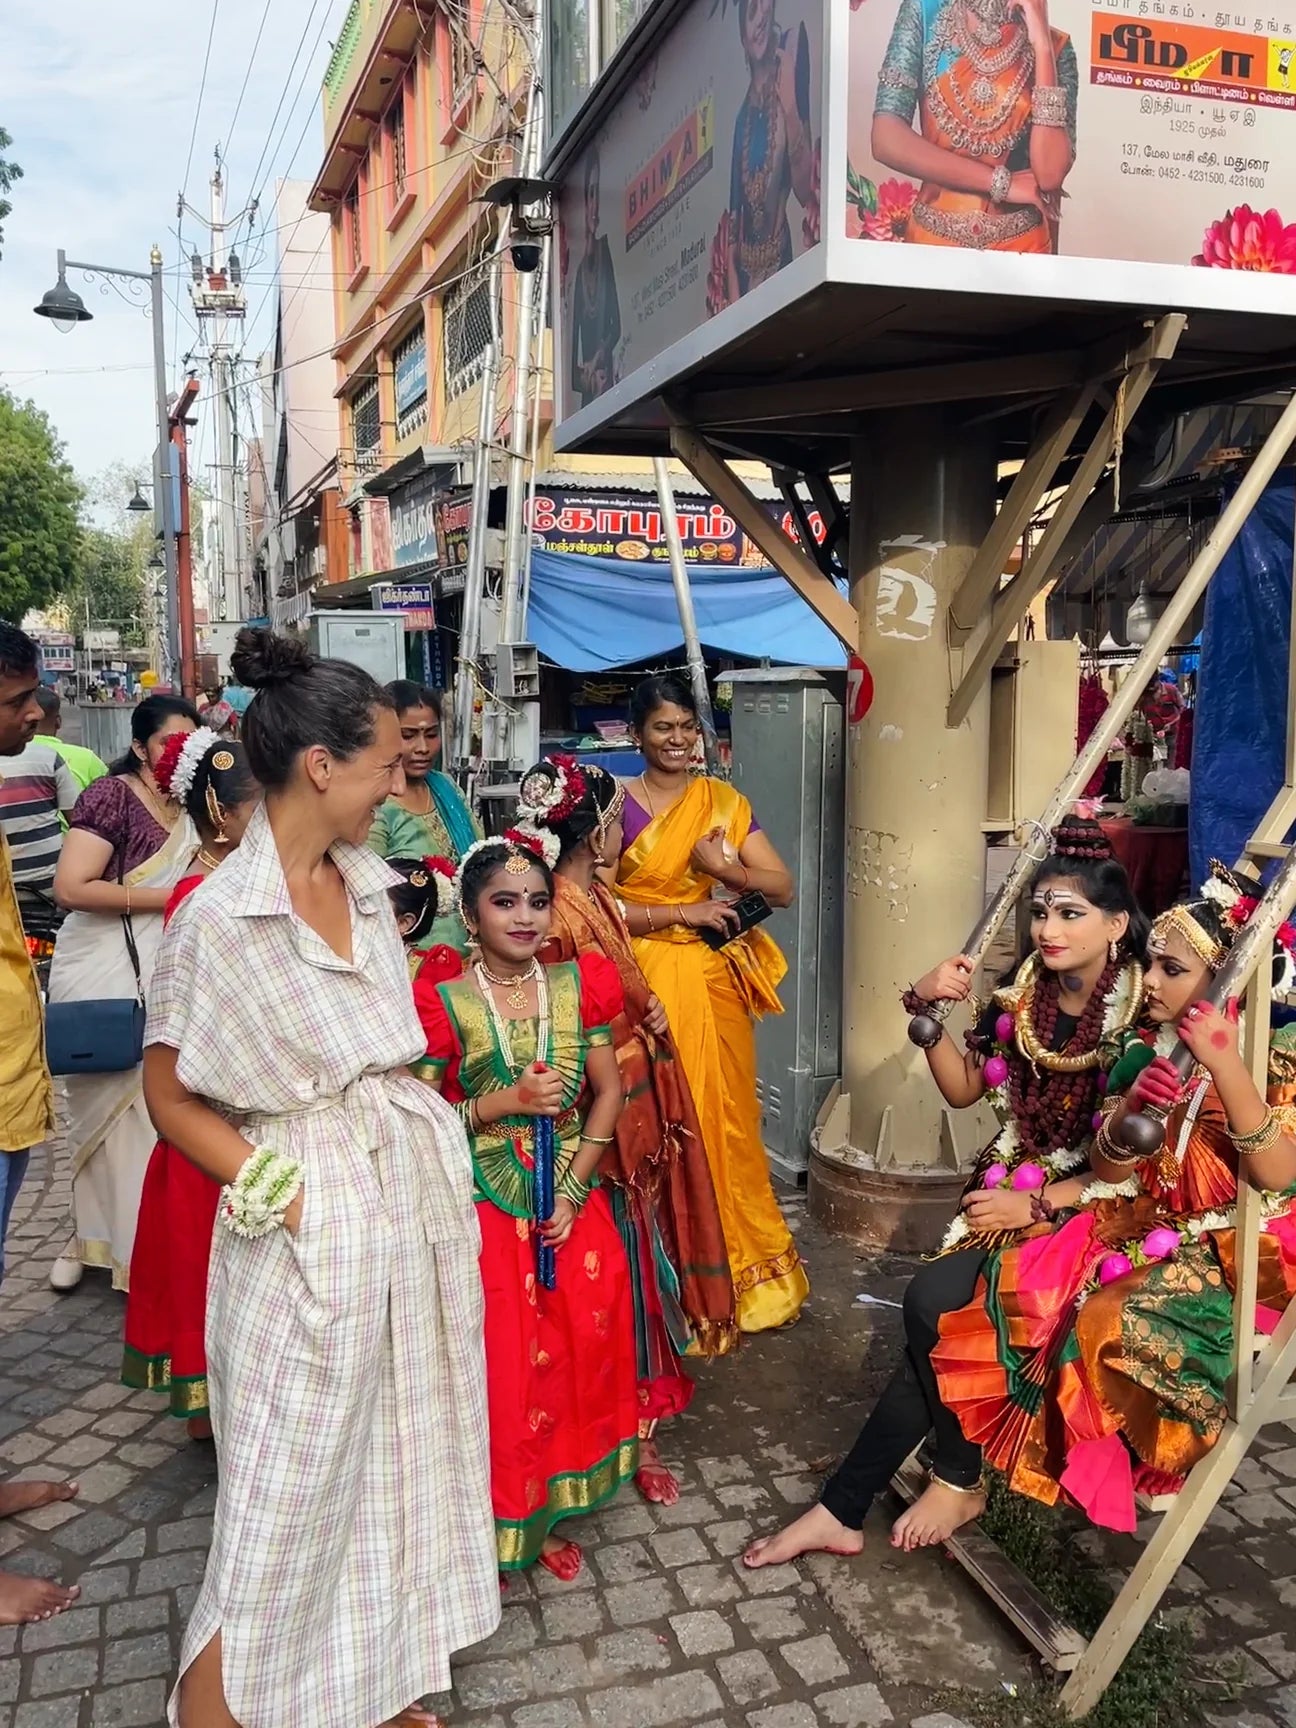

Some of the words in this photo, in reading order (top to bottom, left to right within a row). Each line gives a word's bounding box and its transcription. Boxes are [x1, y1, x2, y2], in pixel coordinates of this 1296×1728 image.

[1138, 0, 1194, 18] தங்கம்
[1215, 12, 1246, 28] தூய
[1099, 23, 1255, 79] பீமா
[1096, 69, 1133, 85] தங்கம்
[1142, 76, 1181, 91] வைரம்
[1190, 81, 1249, 100] பிளாட்டினம்
[1140, 94, 1192, 115] இந்தியா
[1169, 119, 1195, 134] 1925
[1198, 125, 1227, 139] முதல்
[1122, 143, 1141, 158] 137,
[1143, 144, 1170, 159] மேல
[1172, 149, 1195, 162] மாசி
[1223, 157, 1270, 173] மதுரை
[628, 130, 694, 219] BHIMA
[1120, 161, 1155, 177] போன்:
[1158, 166, 1180, 180] 0452
[1187, 169, 1227, 185] 4231500,
[1228, 174, 1265, 189] 4231600
